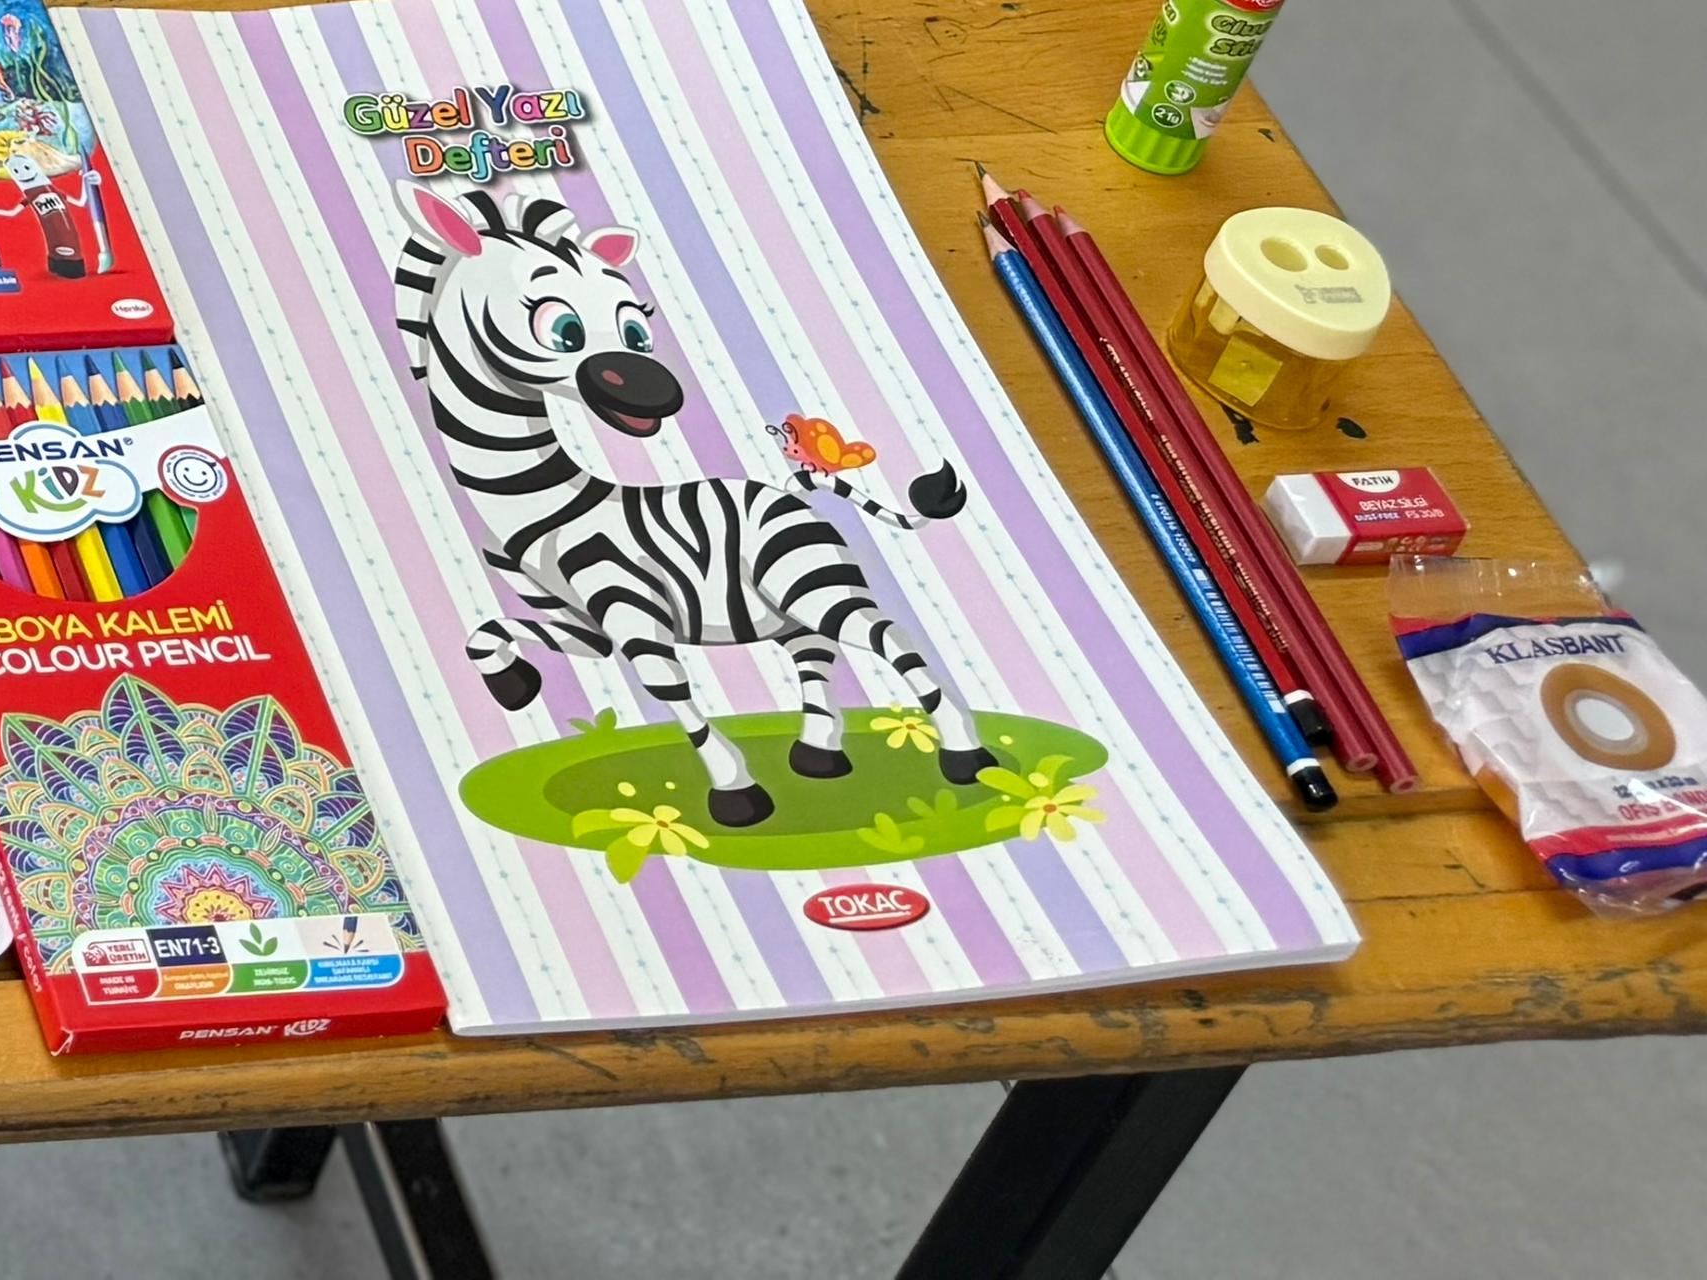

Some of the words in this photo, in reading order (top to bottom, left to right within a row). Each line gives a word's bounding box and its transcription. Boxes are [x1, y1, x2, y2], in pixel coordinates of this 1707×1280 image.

[343, 87, 472, 133] Güzel
[475, 85, 583, 124] Yazı
[404, 126, 573, 182] Defteri
[97, 600, 233, 637] KALEMİ
[137, 634, 271, 669] PENCIL
[1485, 633, 1628, 665] KLASBANT
[154, 937, 221, 957] EN71-3
[179, 1026, 271, 1040] PENSAN
